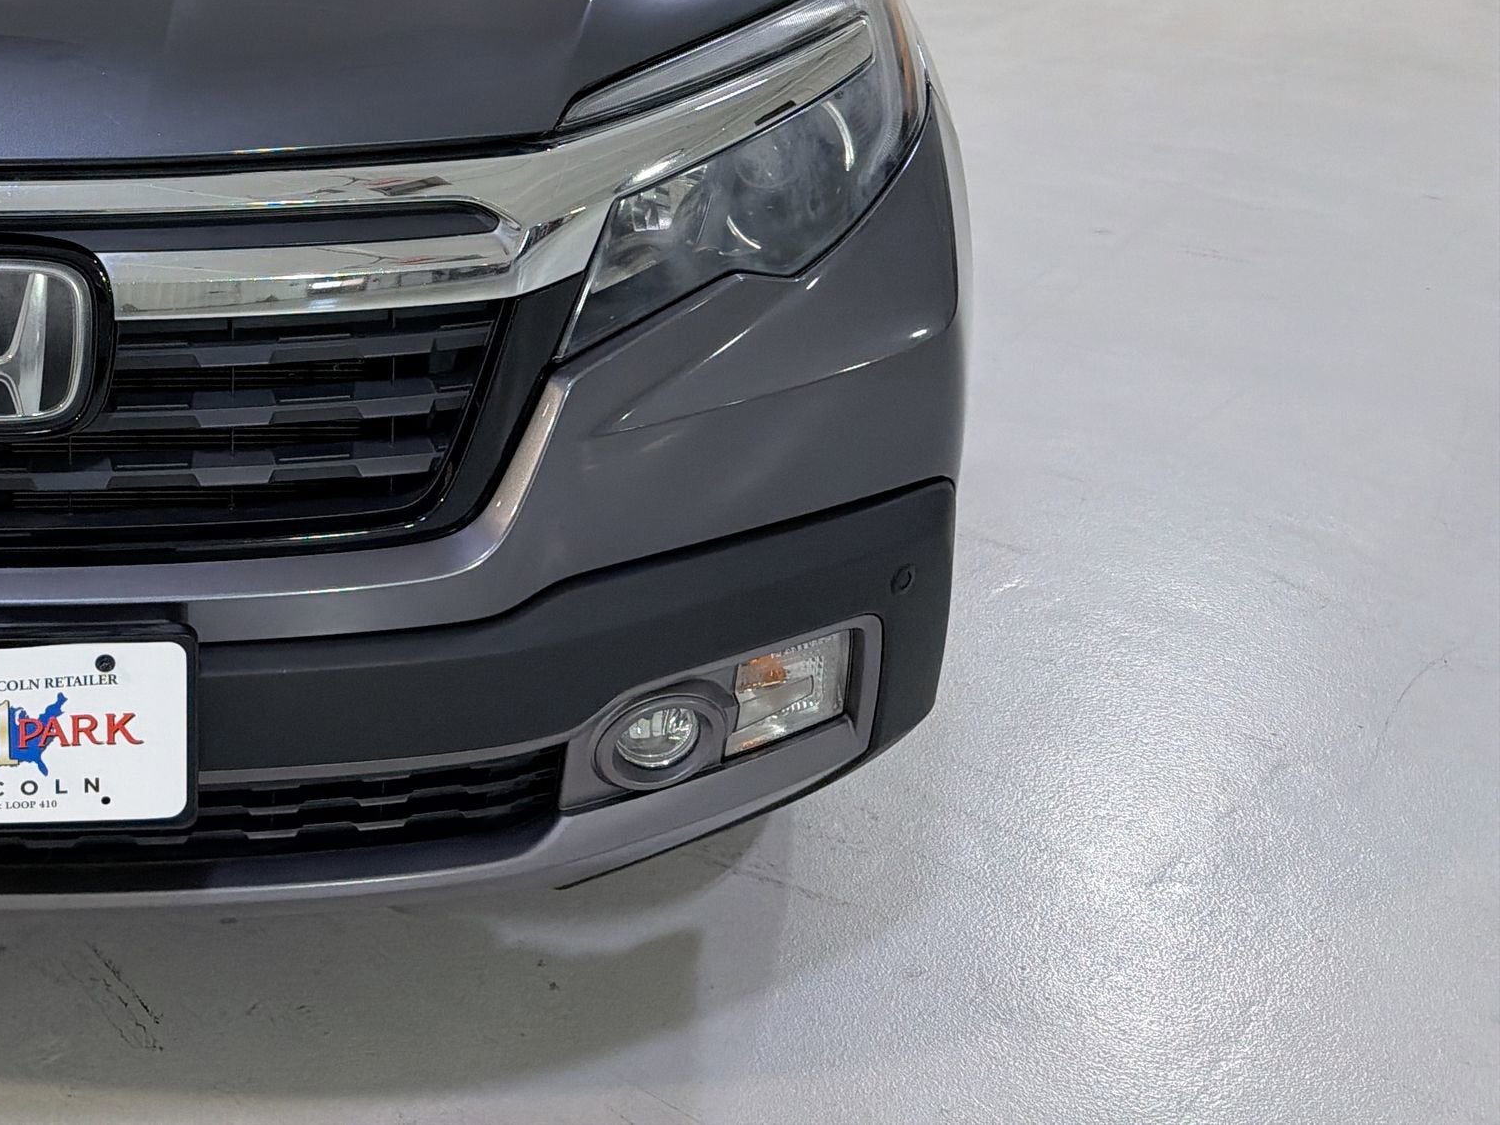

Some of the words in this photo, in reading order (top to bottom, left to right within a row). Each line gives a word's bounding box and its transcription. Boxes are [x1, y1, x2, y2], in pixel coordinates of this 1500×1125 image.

[44, 674, 119, 689] RETAILER
[18, 712, 145, 751] PARK
[5, 800, 37, 810] LOOP
[38, 799, 58, 809] 410
